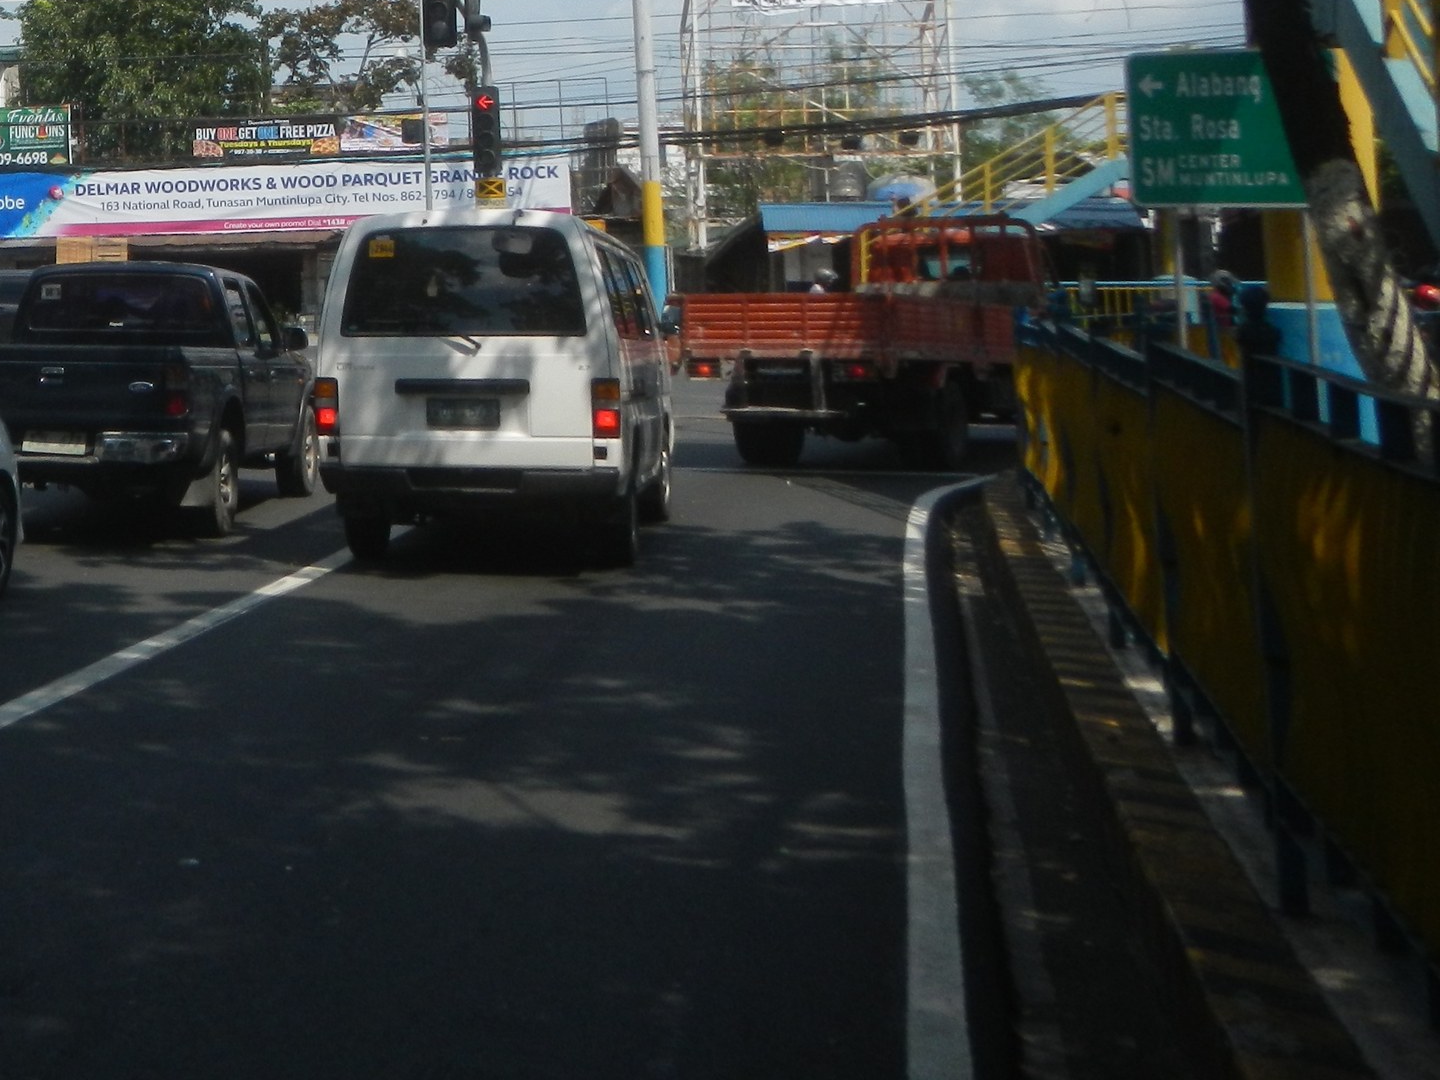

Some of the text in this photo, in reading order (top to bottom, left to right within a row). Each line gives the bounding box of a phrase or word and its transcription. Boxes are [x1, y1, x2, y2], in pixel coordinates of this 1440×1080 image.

[1176, 73, 1263, 103] Alabang
[7, 109, 56, 123] Events
[10, 125, 65, 139] FUNCTONS
[196, 124, 336, 140] BUY ONE GET ONE FREE PIZZA
[1140, 114, 1242, 141] Sta. Rosa
[1142, 154, 1241, 187] SM CENTER
[1179, 171, 1290, 187] MUNTINLUPA
[75, 182, 141, 196] DELMAR
[145, 178, 262, 194] WOODWORKS
[266, 177, 277, 190] &
[281, 174, 337, 189] WOOD
[342, 171, 422, 187] PARQUET
[509, 166, 559, 179] ROCK
[101, 201, 119, 211] 163
[123, 200, 169, 210] National
[173, 198, 204, 209] Road,
[206, 197, 253, 208] Tunasan
[256, 195, 322, 207] Muntinlupa
[325, 193, 350, 205] City.
[353, 192, 369, 203] Tel
[372, 191, 398, 201] Nos.
[401, 189, 456, 201] 862-794
[224, 221, 247, 229] Create
[281, 220, 306, 228] promo!
[308, 219, 321, 227] Dial
